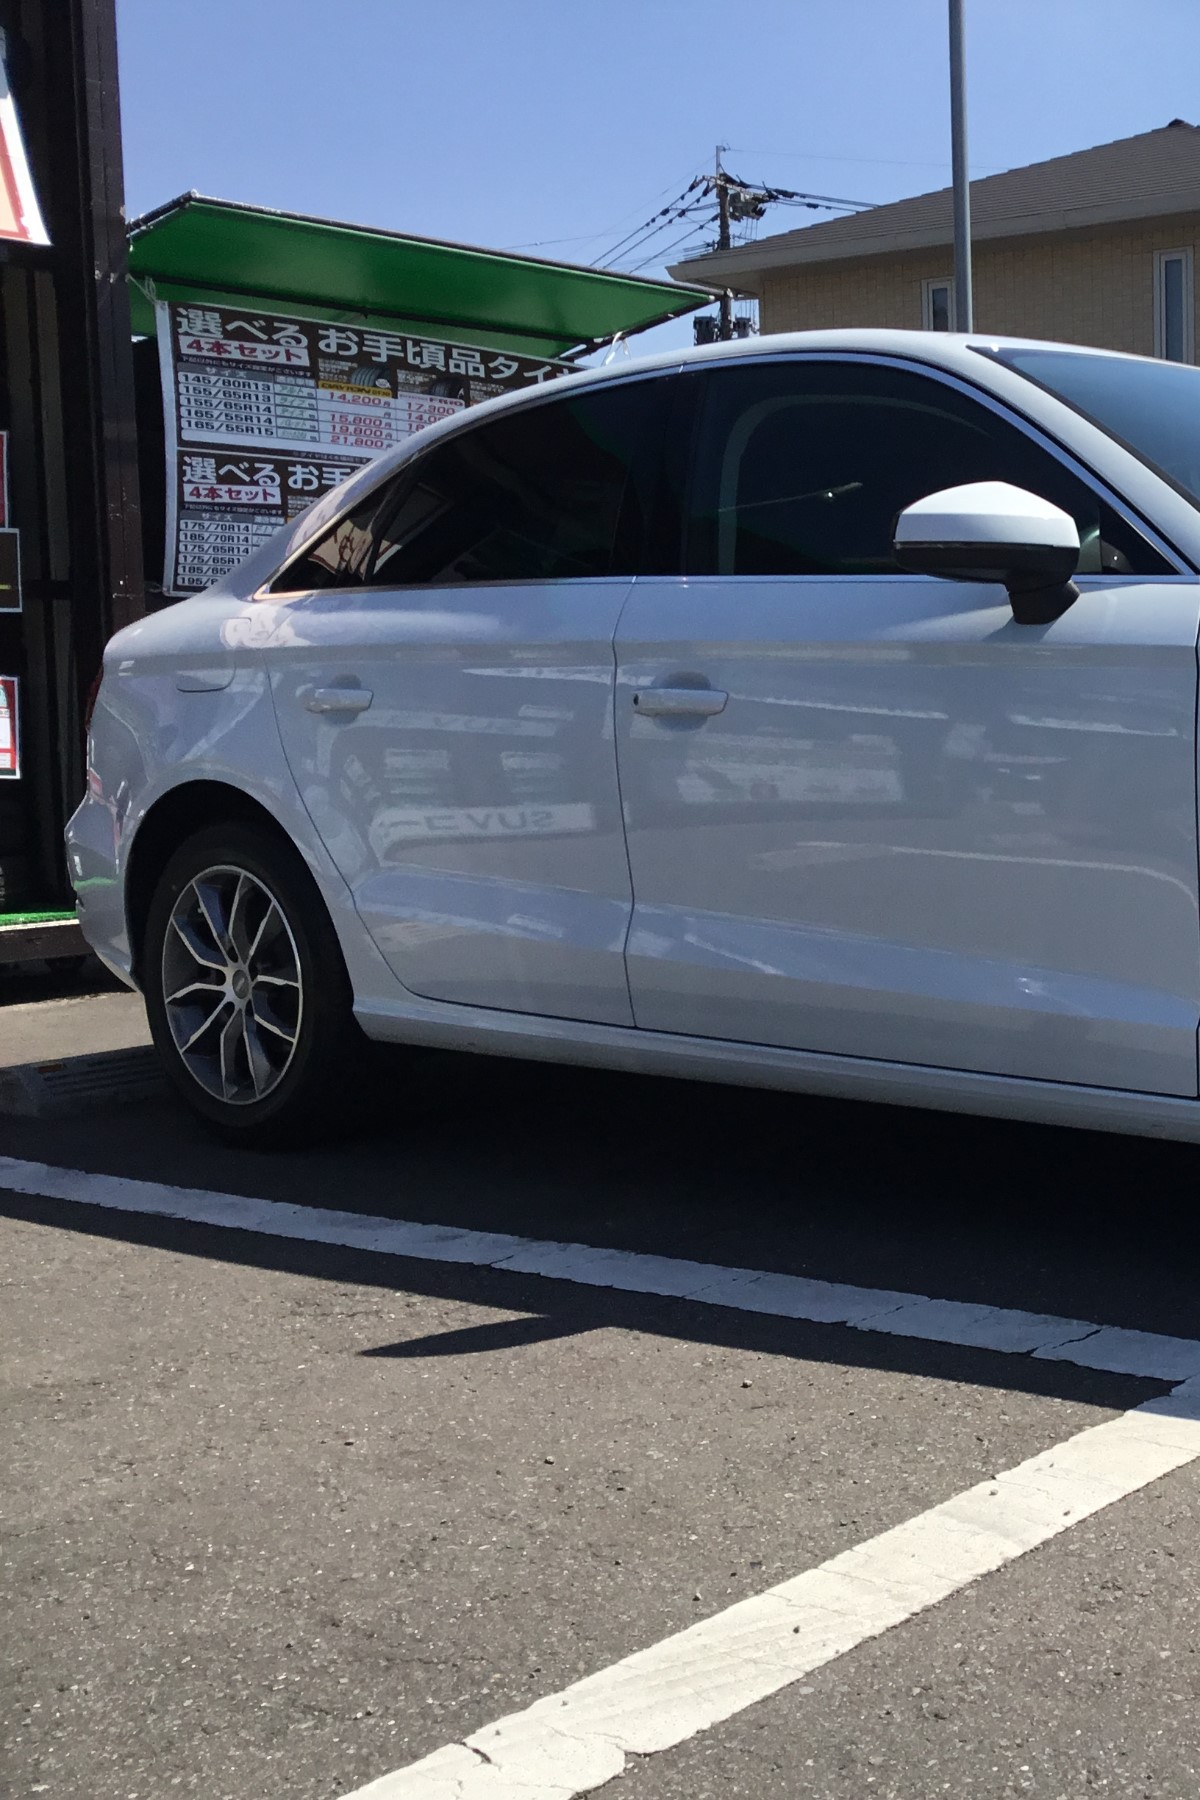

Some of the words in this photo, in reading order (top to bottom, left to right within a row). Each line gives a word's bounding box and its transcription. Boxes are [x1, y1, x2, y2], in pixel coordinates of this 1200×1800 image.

[186, 339, 302, 361] 4本セット
[183, 374, 271, 392] 145/80R13
[184, 385, 271, 402] 155/65R13
[185, 397, 272, 414] 155/65R14
[185, 409, 273, 425] 165/55R14
[186, 420, 274, 436] 165/55R15
[183, 456, 281, 487] 選べる
[188, 486, 276, 501] 4本セット
[183, 521, 250, 532] 175/70R14
[182, 532, 249, 543] 185/70R14
[182, 543, 250, 555] 175/65R14
